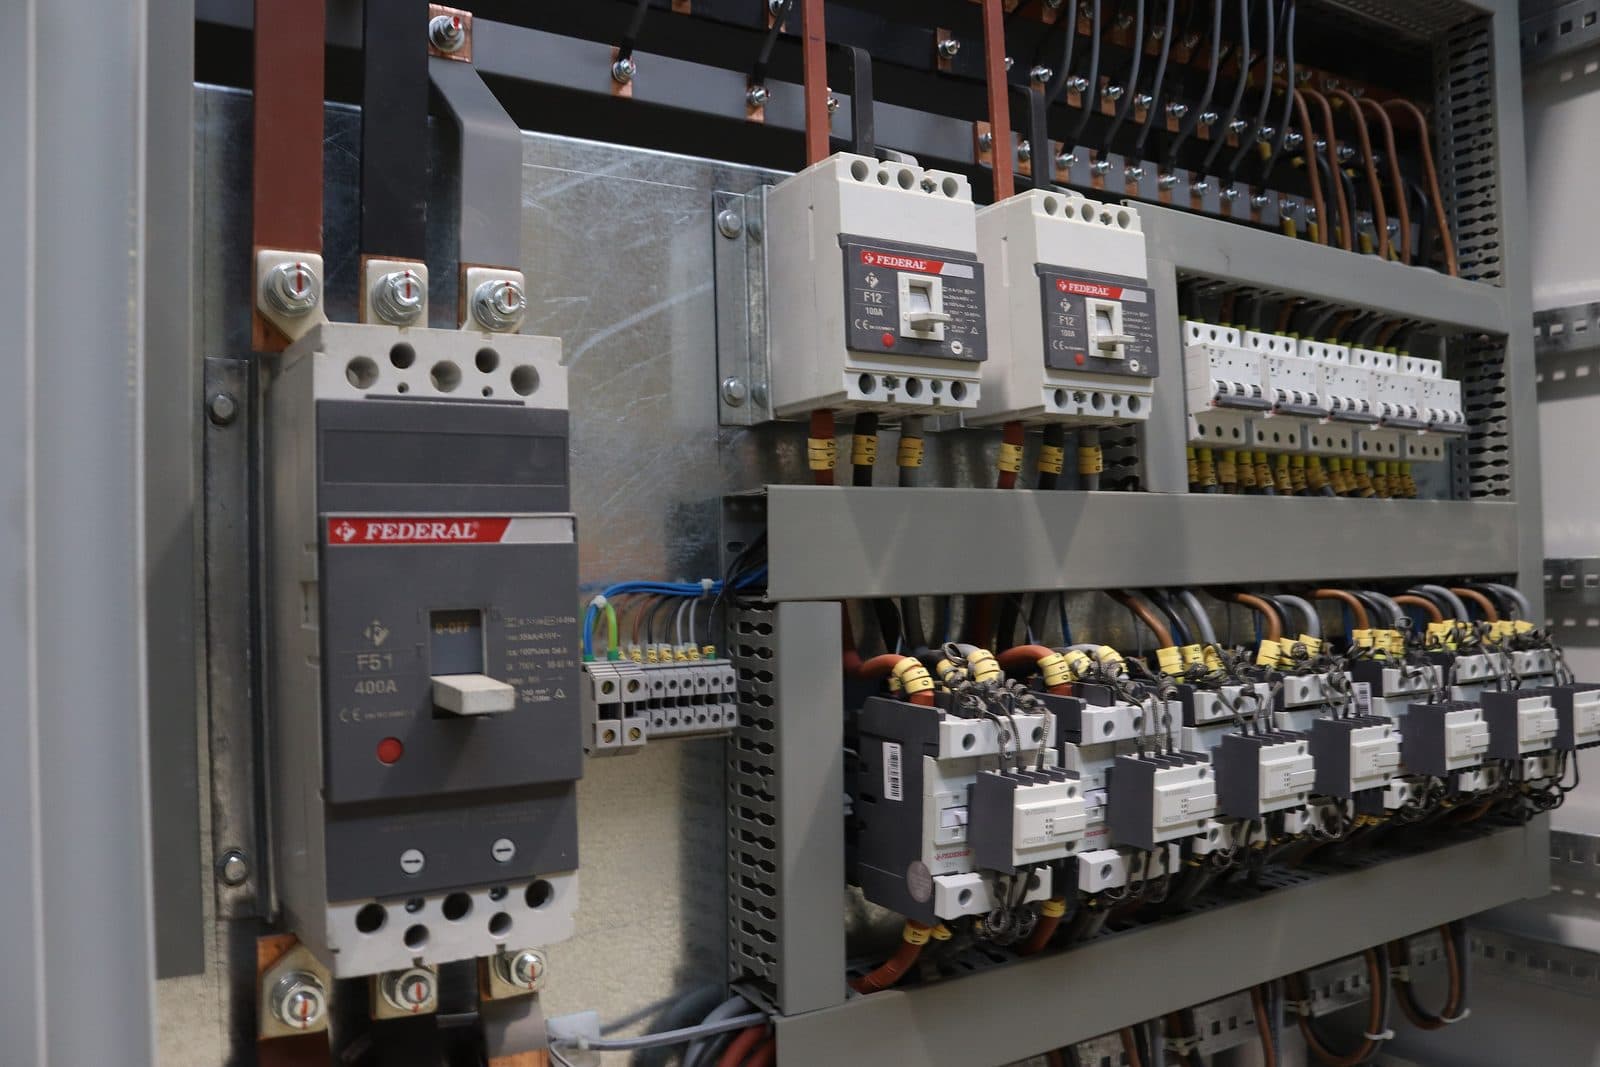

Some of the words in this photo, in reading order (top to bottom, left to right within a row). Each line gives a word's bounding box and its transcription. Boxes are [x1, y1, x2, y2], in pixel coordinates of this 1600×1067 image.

[876, 255, 927, 270] FEDERAL
[1068, 283, 1109, 296] FEDERAL
[863, 291, 882, 304] F12
[865, 307, 884, 317] 100A
[1058, 315, 1075, 327] F12
[365, 522, 477, 541] FEDERAL
[356, 653, 393, 672] F51
[354, 679, 399, 695] 400A
